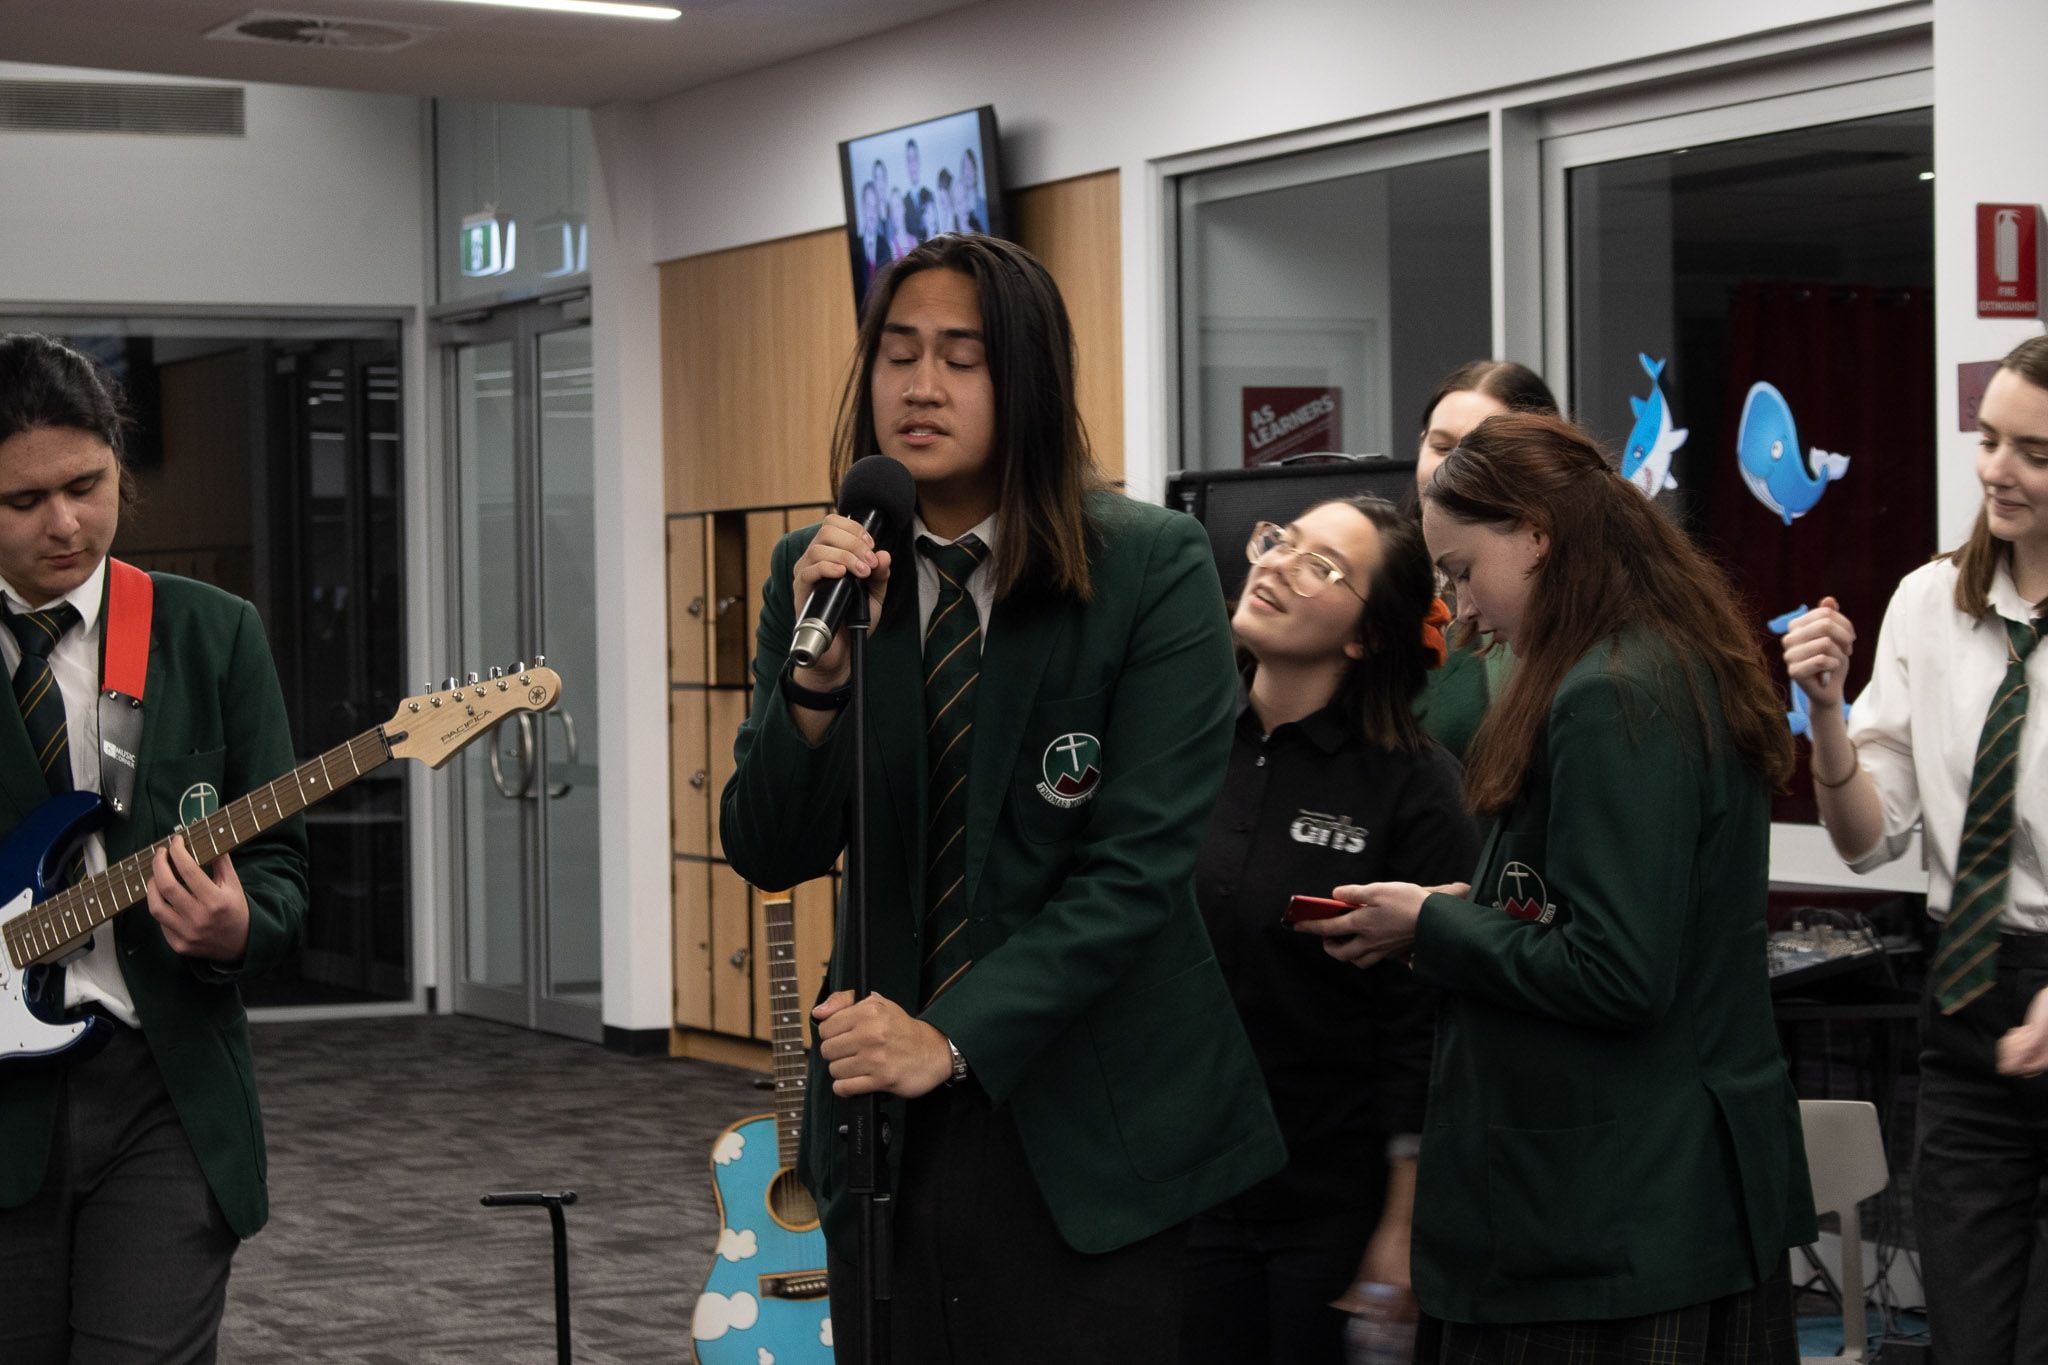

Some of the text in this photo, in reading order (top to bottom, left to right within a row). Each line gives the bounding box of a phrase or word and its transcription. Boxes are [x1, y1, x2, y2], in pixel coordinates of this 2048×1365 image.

[1998, 286, 2018, 297] FIRE
[1979, 301, 2037, 312] EXTINGUISHER
[1248, 394, 1335, 449] LEARNERS
[1250, 404, 1276, 429] AS
[441, 710, 492, 743] PACIFICA
[115, 746, 136, 763] MUSIC
[1038, 784, 1068, 807] THOMAS
